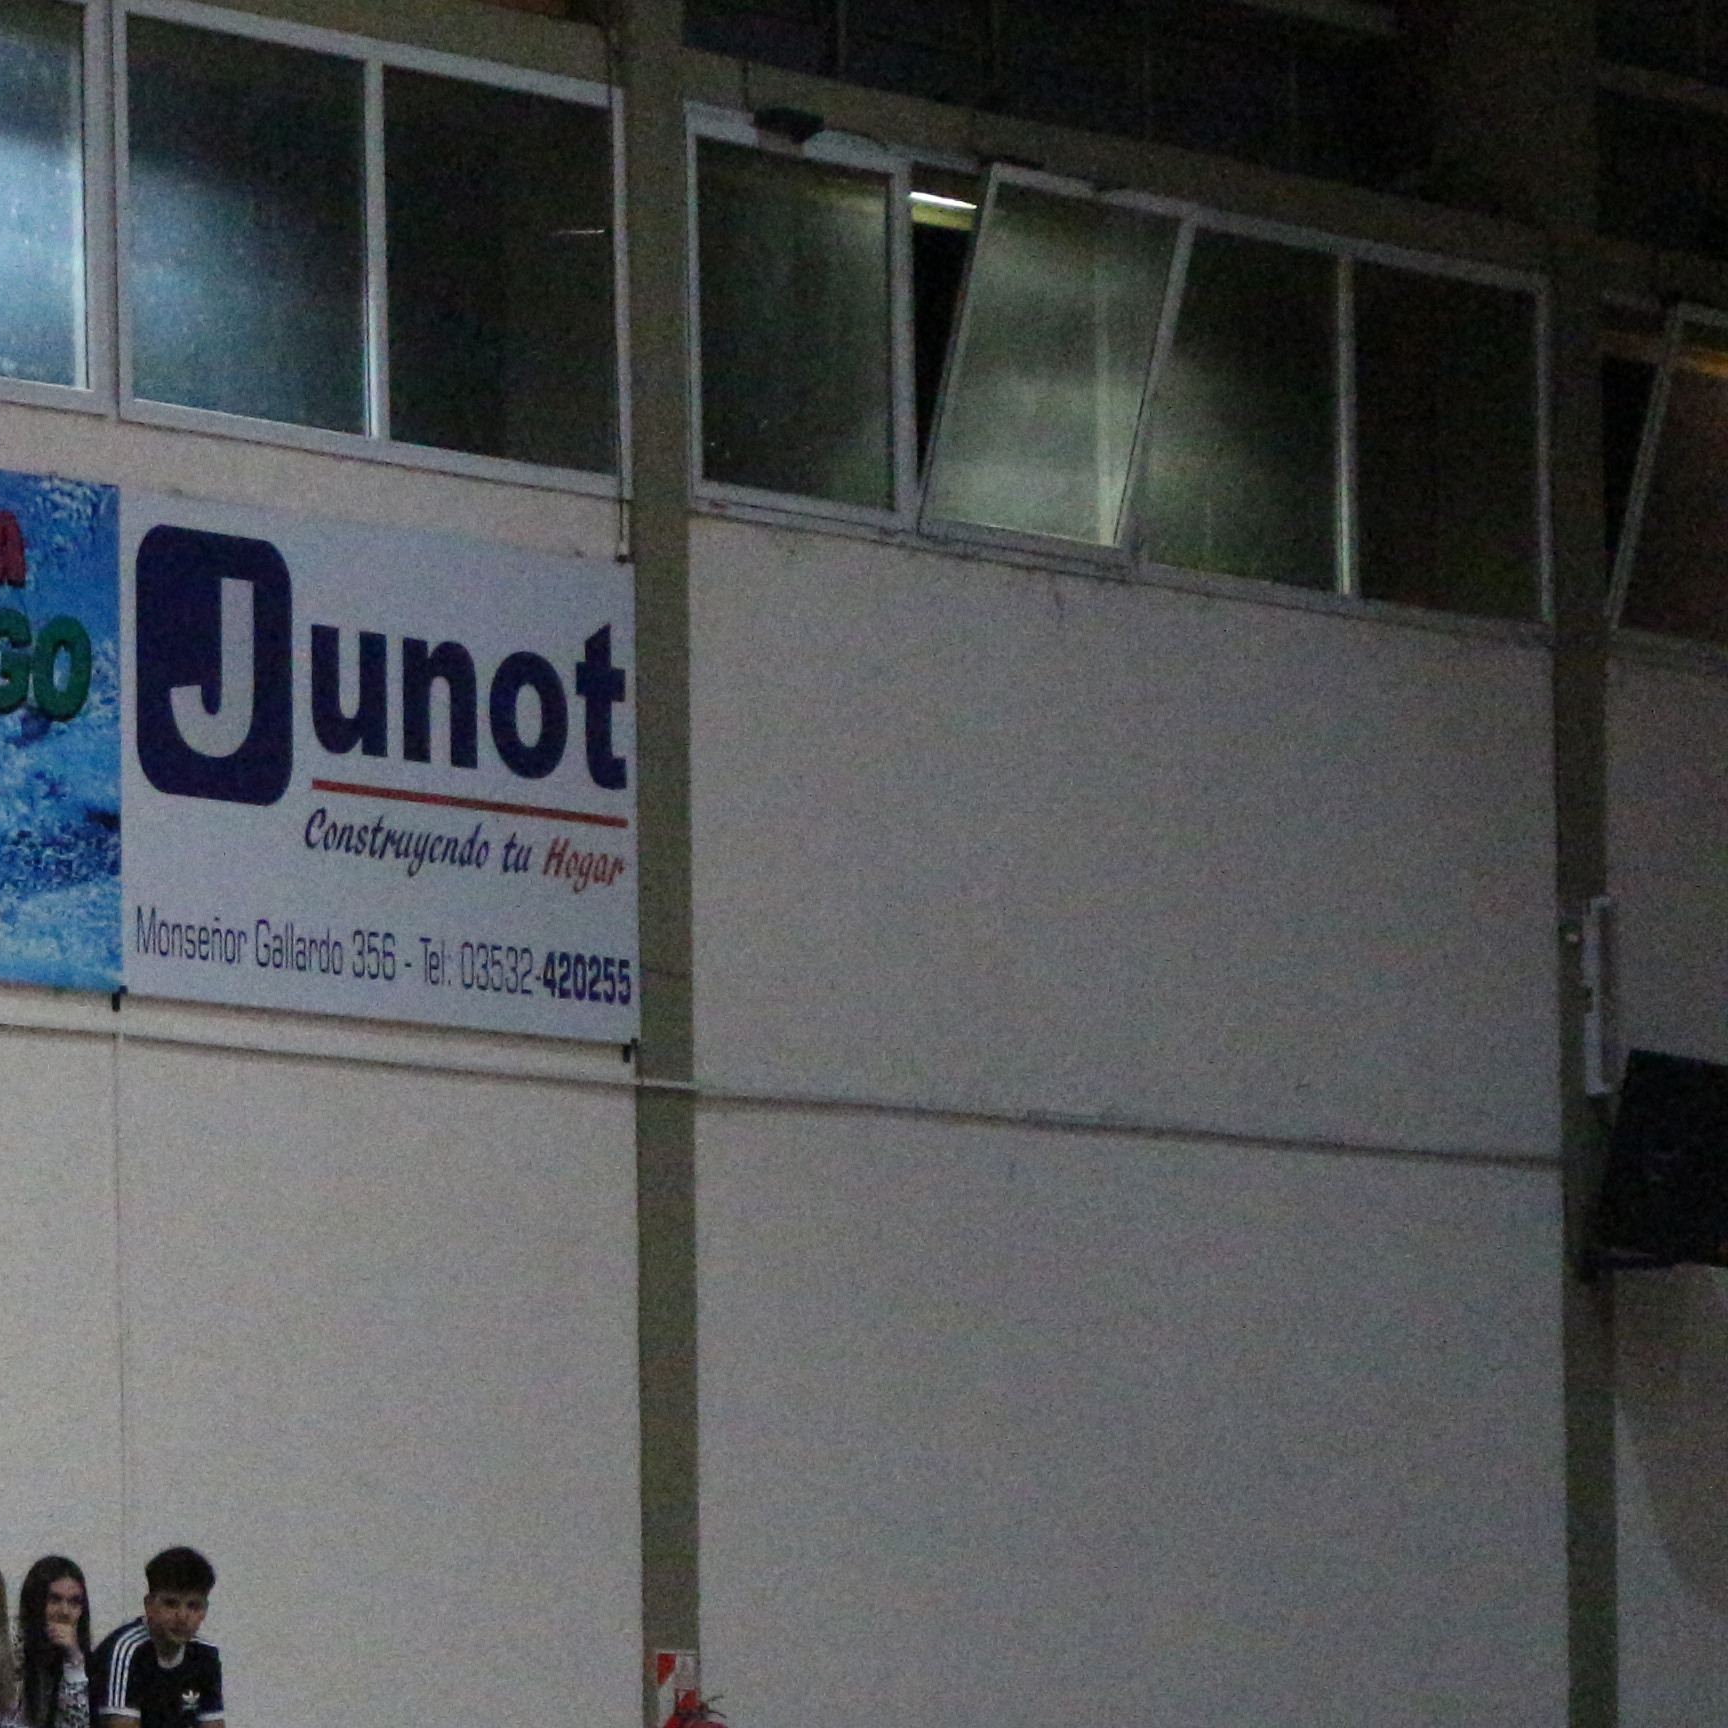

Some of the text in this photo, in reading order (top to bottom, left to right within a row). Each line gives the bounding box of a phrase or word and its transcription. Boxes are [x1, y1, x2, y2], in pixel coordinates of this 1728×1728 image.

[170, 578, 627, 790] Junot
[305, 807, 625, 893] Construyendo tu Hogar
[137, 906, 246, 965] Monseñor
[255, 920, 343, 976] Gallardo
[352, 931, 395, 981] 356
